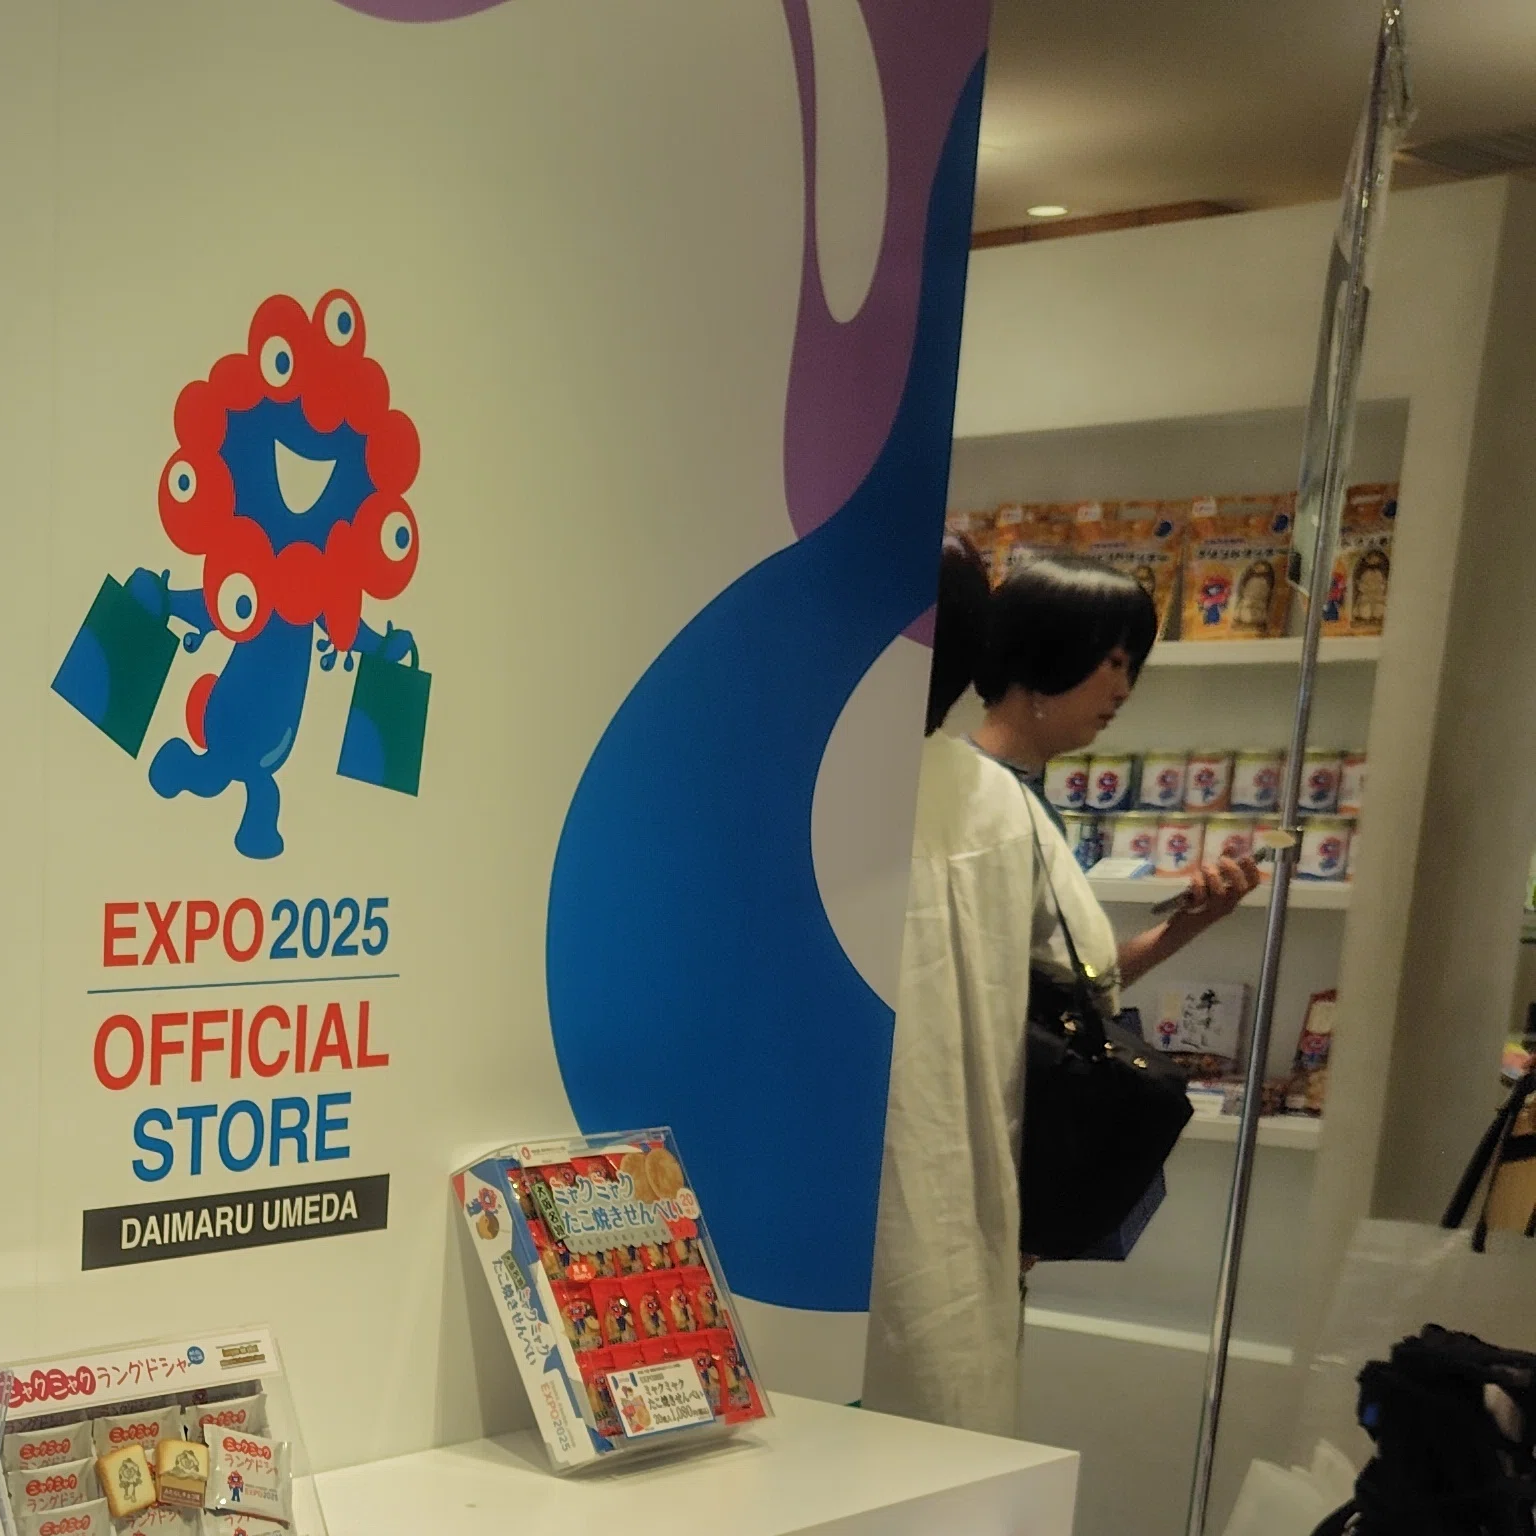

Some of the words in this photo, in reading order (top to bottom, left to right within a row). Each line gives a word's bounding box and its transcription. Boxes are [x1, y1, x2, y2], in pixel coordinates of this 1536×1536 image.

[93, 1000, 390, 1091] OFFICIAL
[132, 1091, 352, 1183] STORE
[120, 1202, 254, 1251] DAIMARU
[262, 1189, 359, 1232] UMEDA
[564, 1200, 683, 1235] たこ焼きせんべい
